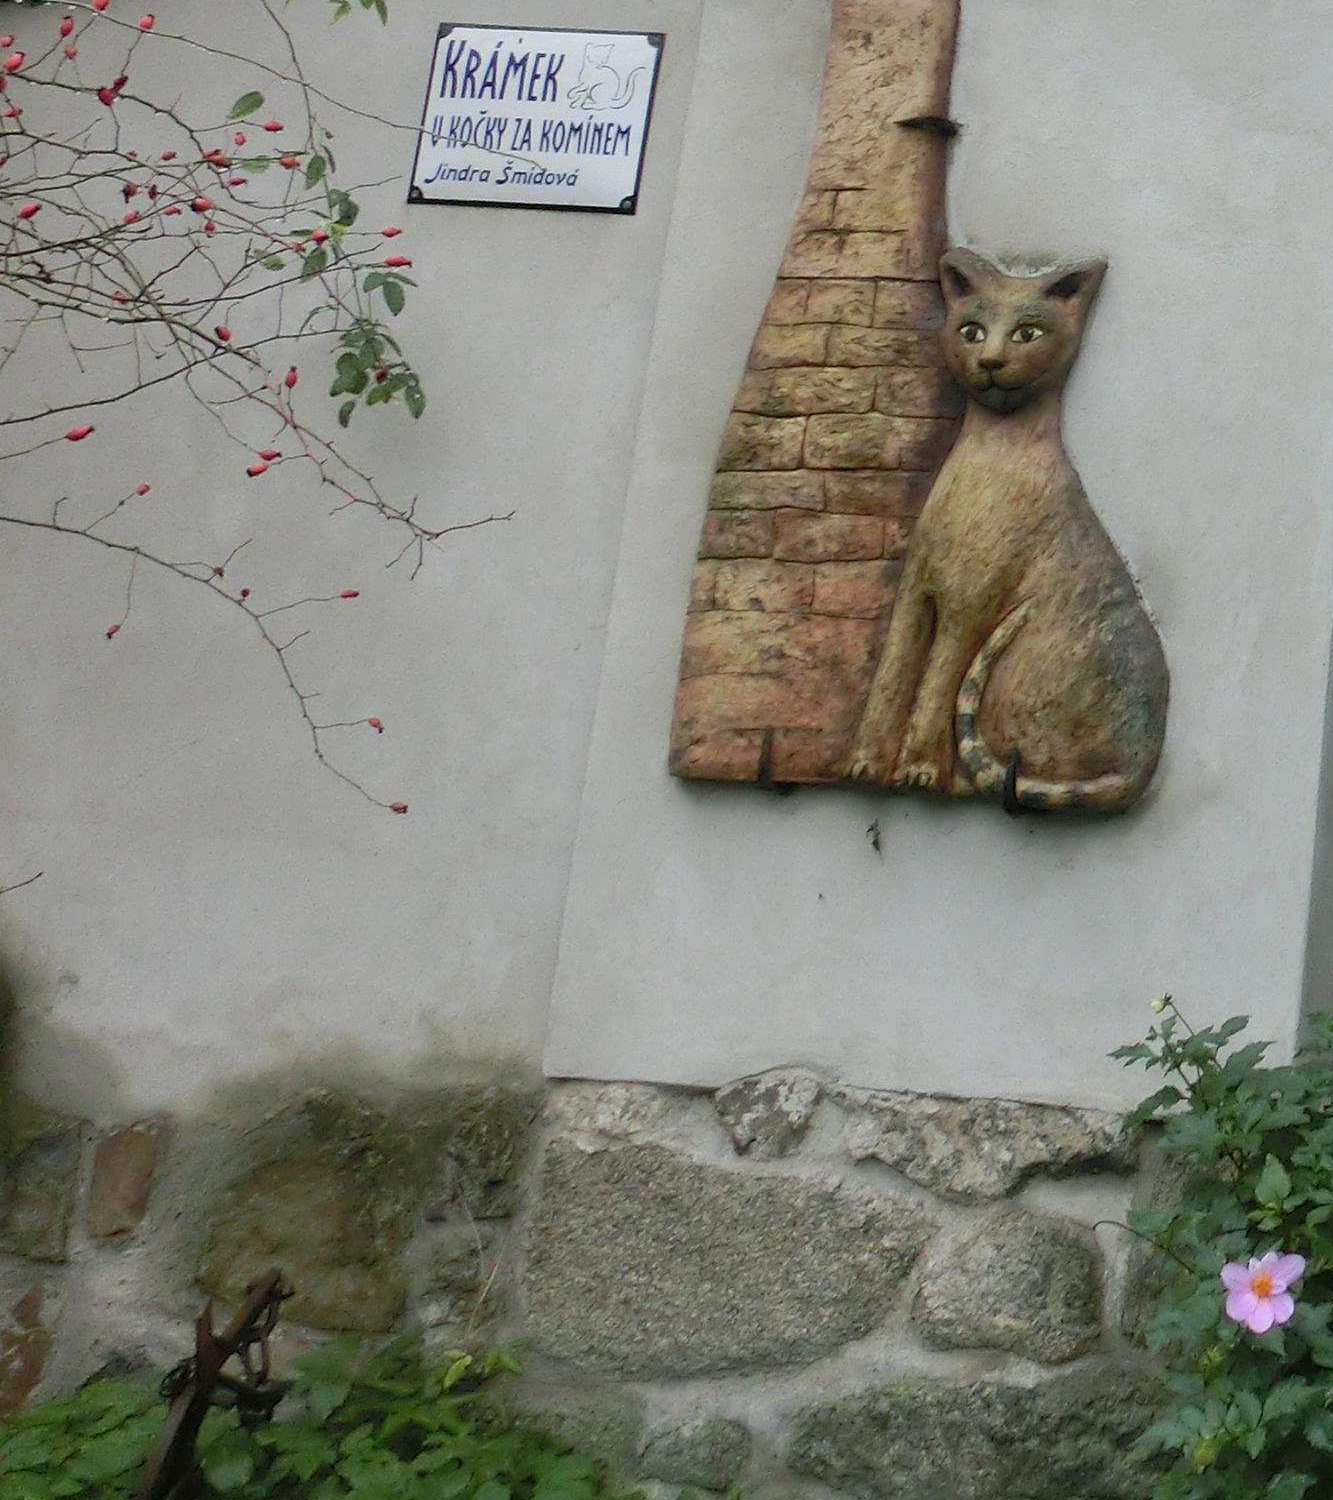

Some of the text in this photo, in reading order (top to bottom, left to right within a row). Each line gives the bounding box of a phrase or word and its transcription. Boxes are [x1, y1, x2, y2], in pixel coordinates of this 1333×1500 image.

[439, 38, 566, 102] KRÁMEK
[431, 110, 633, 157] U KOČKY ZA KOMÍNEM
[423, 163, 491, 184] Jindra
